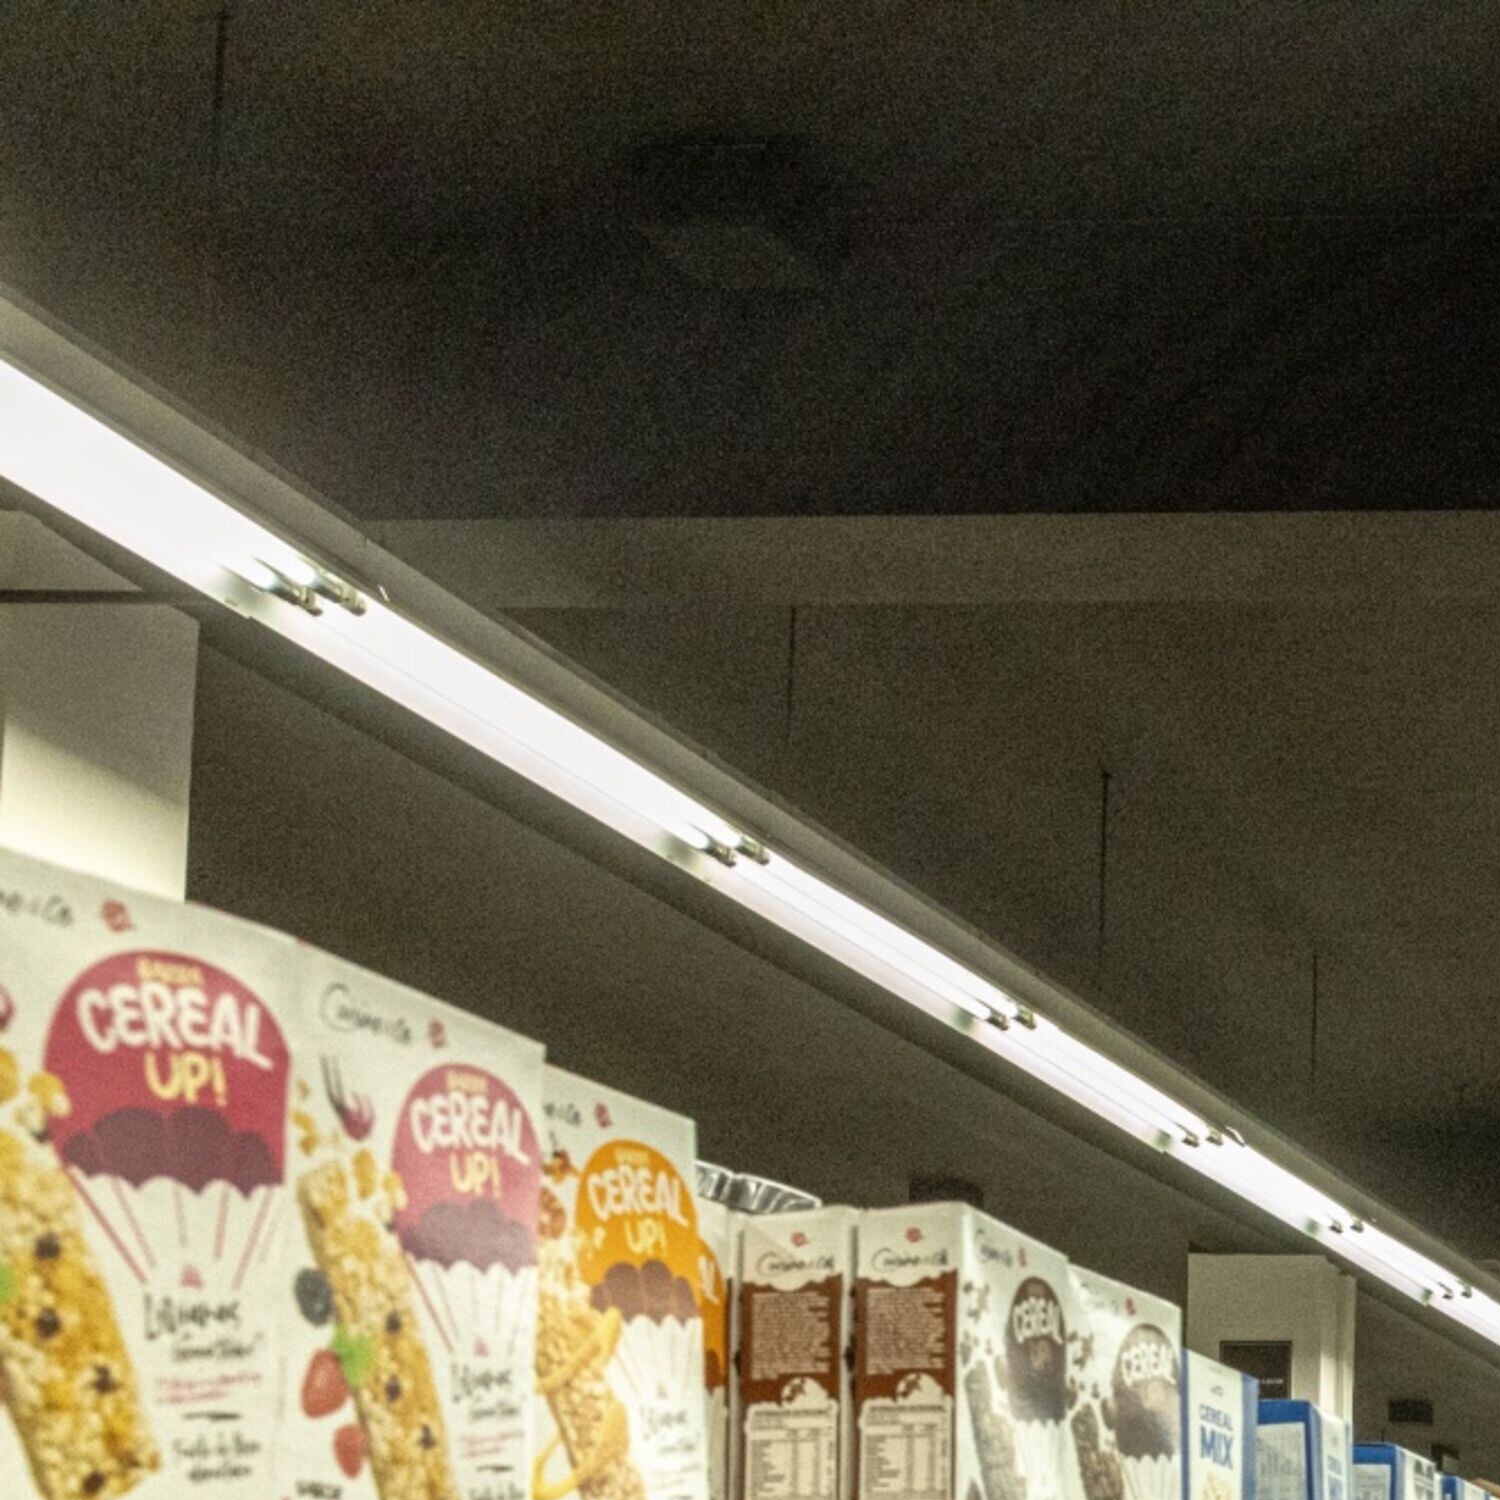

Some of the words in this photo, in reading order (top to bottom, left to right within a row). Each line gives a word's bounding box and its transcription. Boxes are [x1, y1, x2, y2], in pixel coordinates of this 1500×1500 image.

[76, 981, 274, 1071] CEREAL
[145, 1051, 228, 1107] UP!
[410, 1094, 530, 1165] CEREAL
[450, 1151, 499, 1198] UP!
[587, 1167, 689, 1228] CEREAL
[625, 1219, 668, 1258] UP!
[1012, 1297, 1064, 1345] CEREAL
[1121, 1342, 1178, 1389] CEREAL
[1199, 1404, 1232, 1432] CEREAL
[1199, 1425, 1234, 1470] MIX
